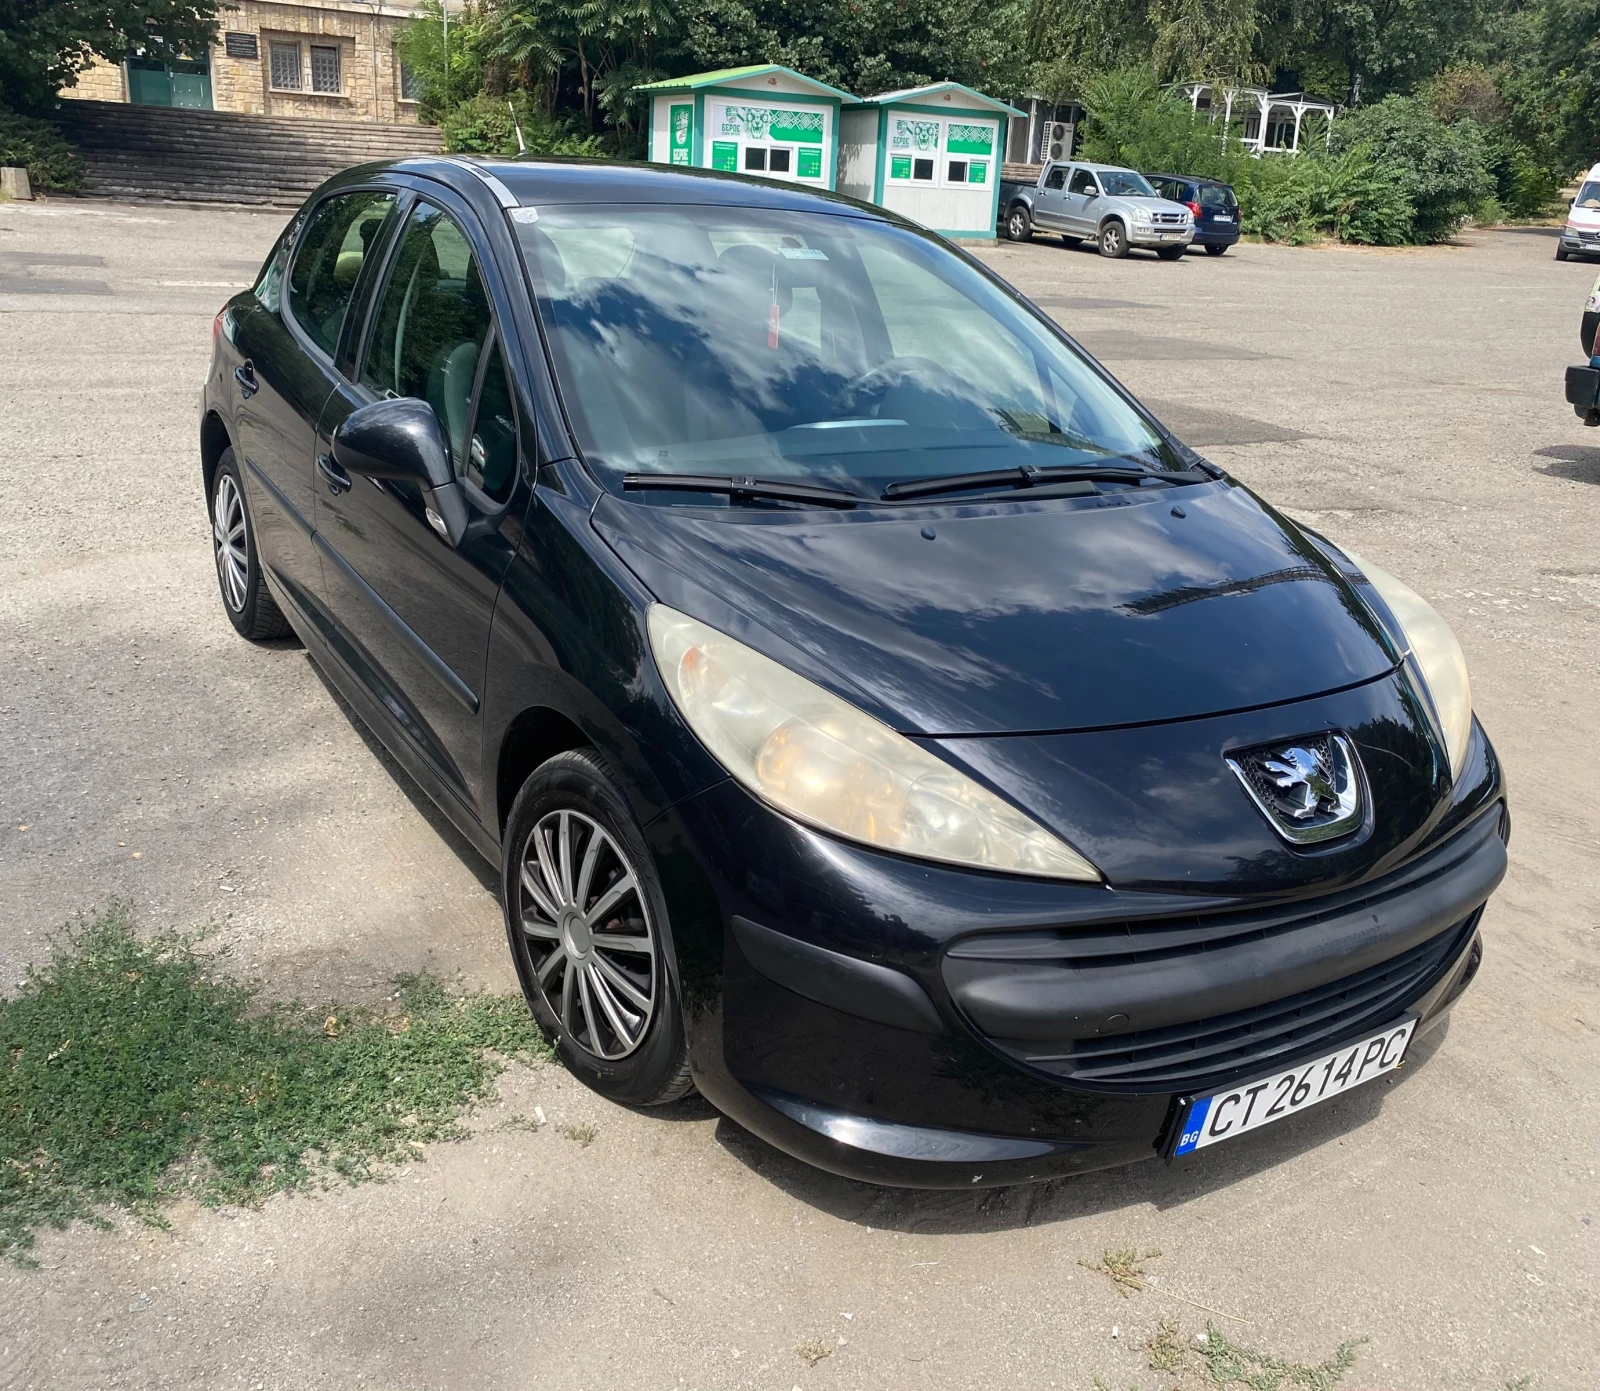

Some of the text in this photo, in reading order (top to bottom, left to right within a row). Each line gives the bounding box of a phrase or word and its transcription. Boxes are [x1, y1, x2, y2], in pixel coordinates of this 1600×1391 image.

[721, 123, 741, 133] БЕРОЕ
[672, 148, 689, 160] БЕРОЕ
[1209, 1028, 1407, 1137] CT 2614 PC
[1180, 1130, 1199, 1147] BG
